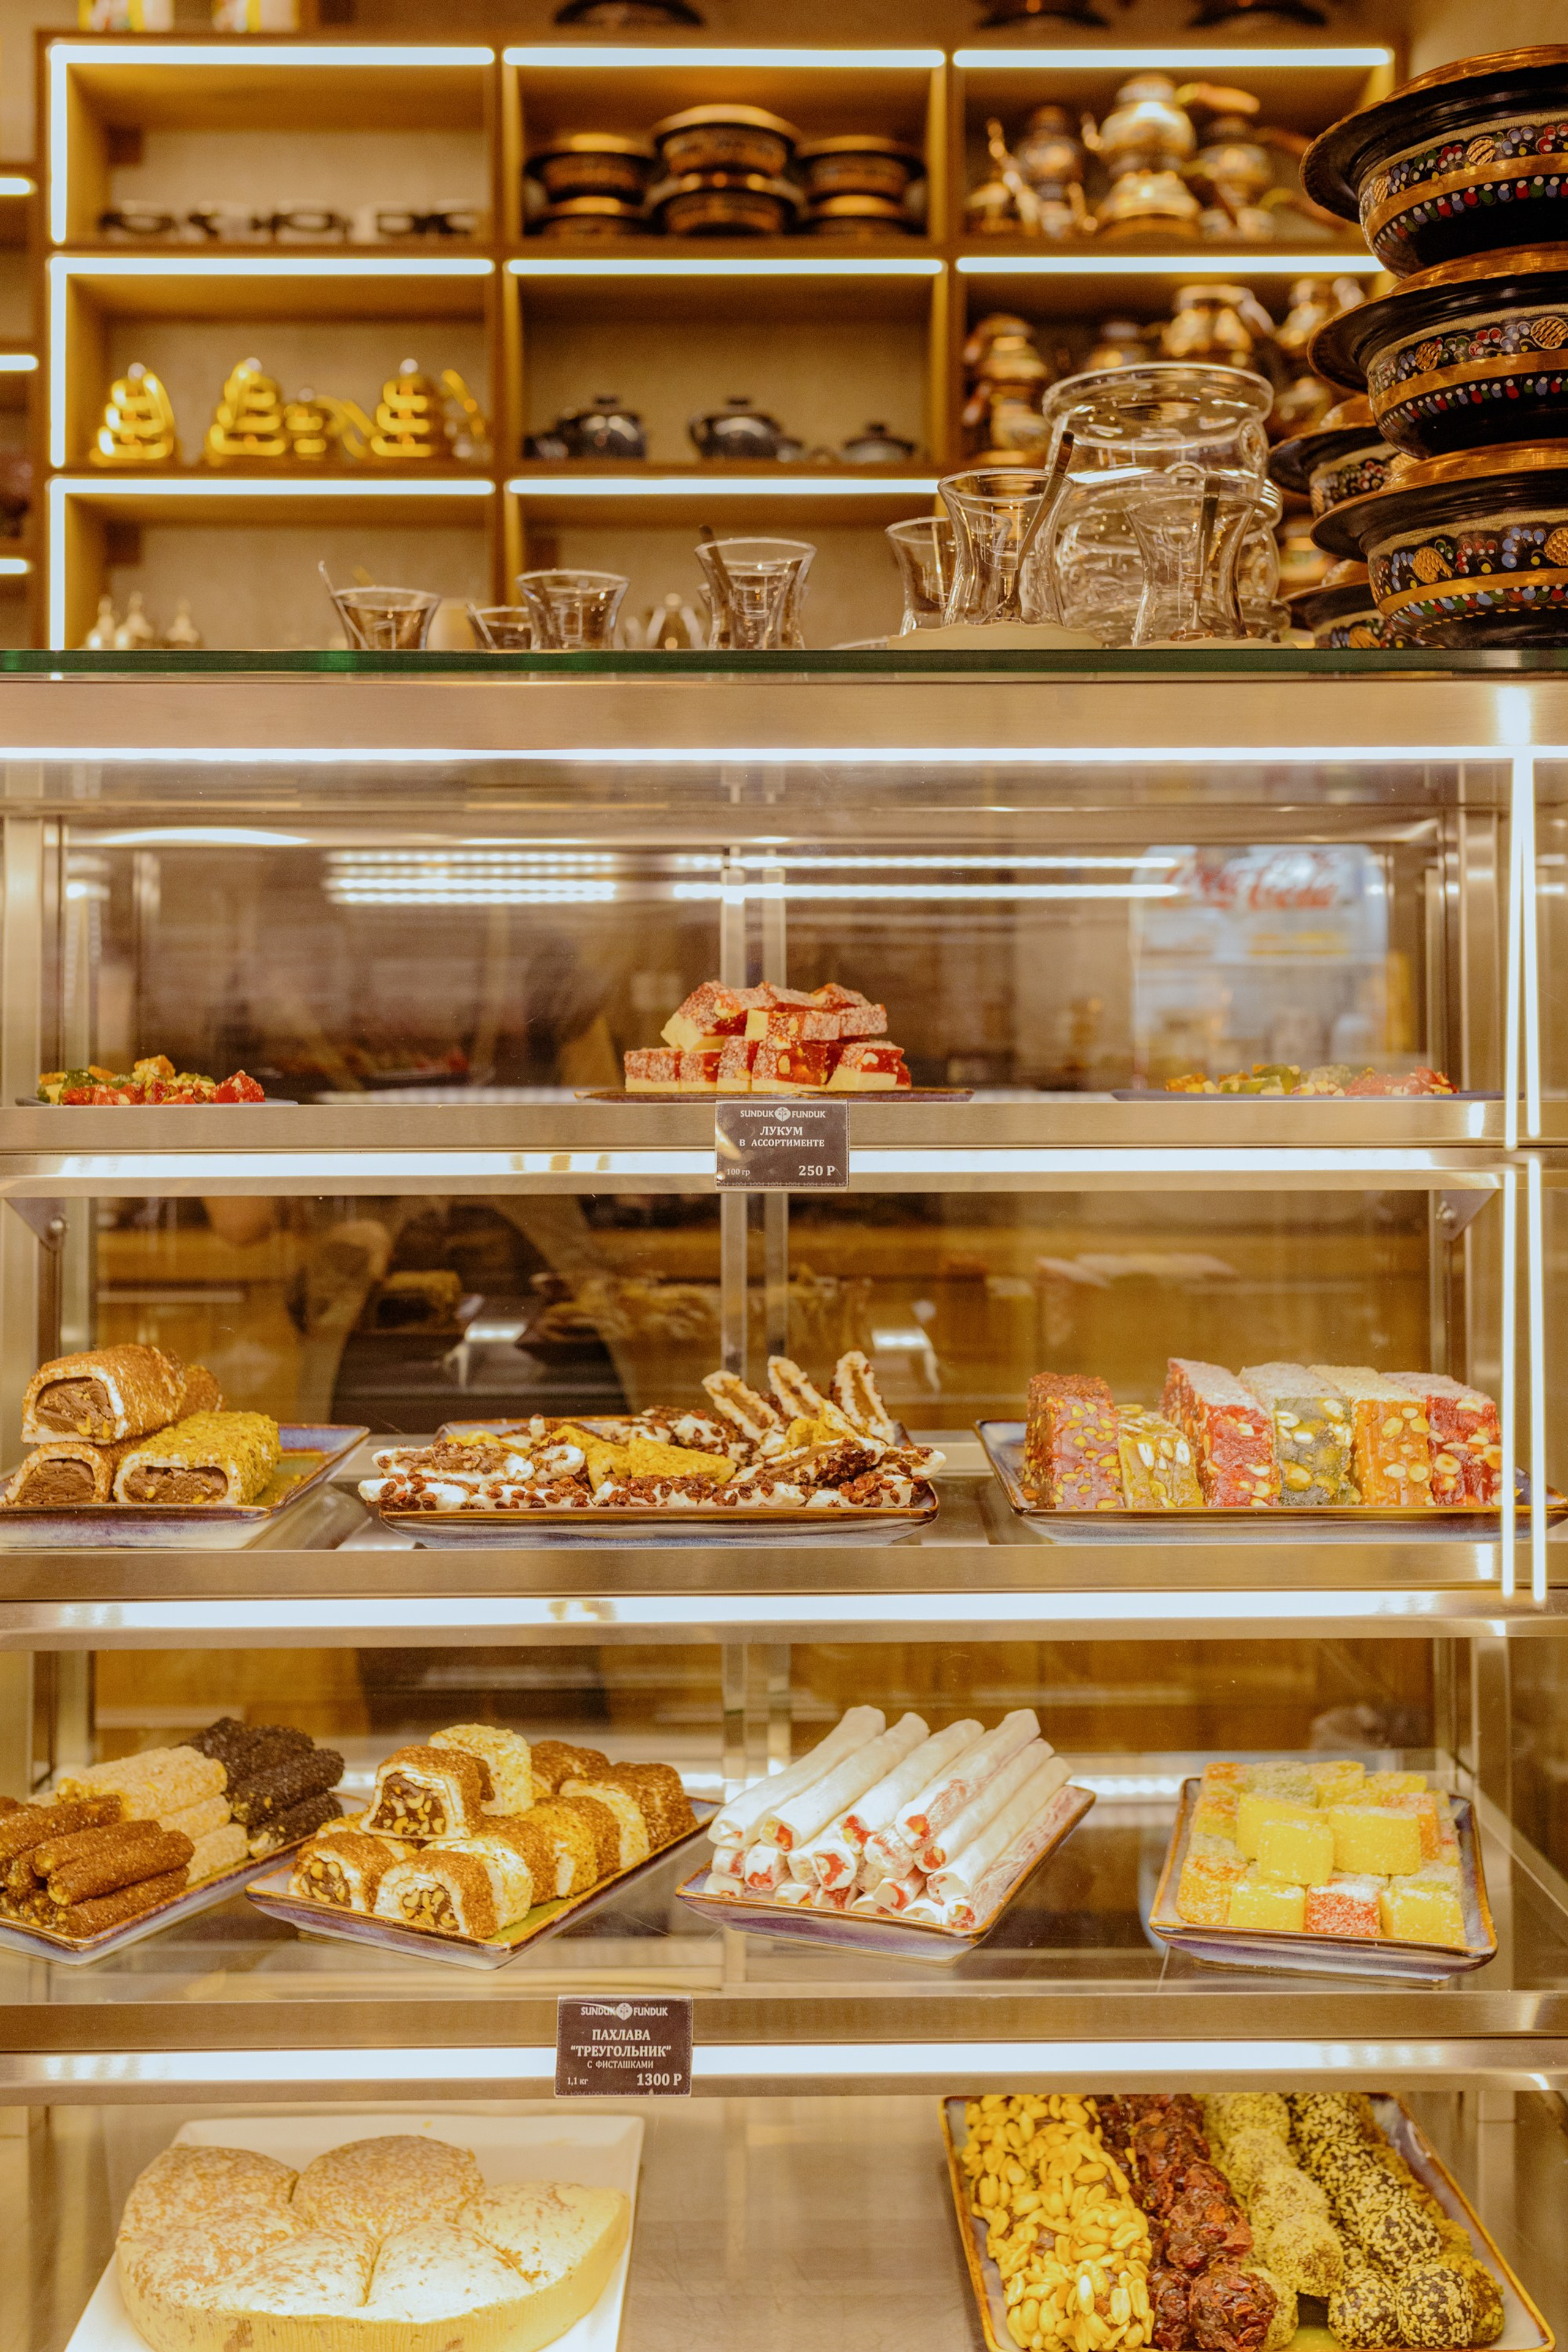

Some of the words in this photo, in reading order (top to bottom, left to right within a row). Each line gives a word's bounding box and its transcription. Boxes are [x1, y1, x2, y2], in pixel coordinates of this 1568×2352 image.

[760, 1126, 803, 1136] ЛУКУМ
[799, 1165, 823, 1176] 250
[581, 2007, 616, 2016] SUNDUK
[633, 2007, 668, 2016] FUNDUK
[592, 2029, 650, 2040] ПАХЛАВА
[567, 2077, 577, 2086] 1,1
[636, 2073, 670, 2086] 1300
